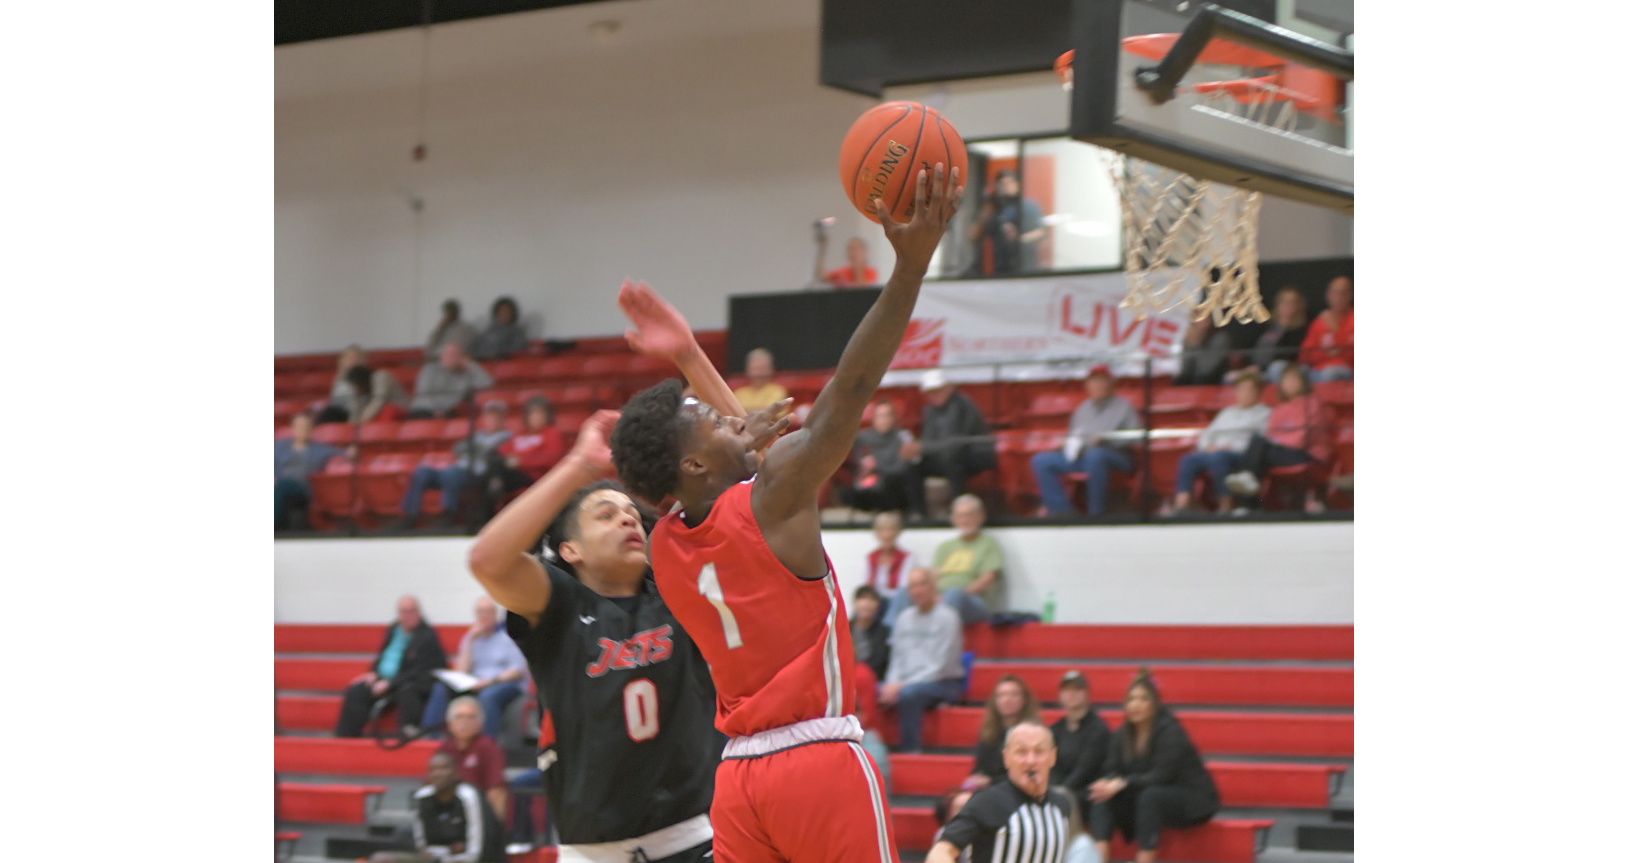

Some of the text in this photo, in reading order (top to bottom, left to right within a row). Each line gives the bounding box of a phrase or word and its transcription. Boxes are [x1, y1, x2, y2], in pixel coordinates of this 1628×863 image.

[1061, 294, 1179, 357] LIVE
[698, 561, 743, 649] 1
[587, 624, 674, 679] JETS
[624, 678, 660, 741] 0
